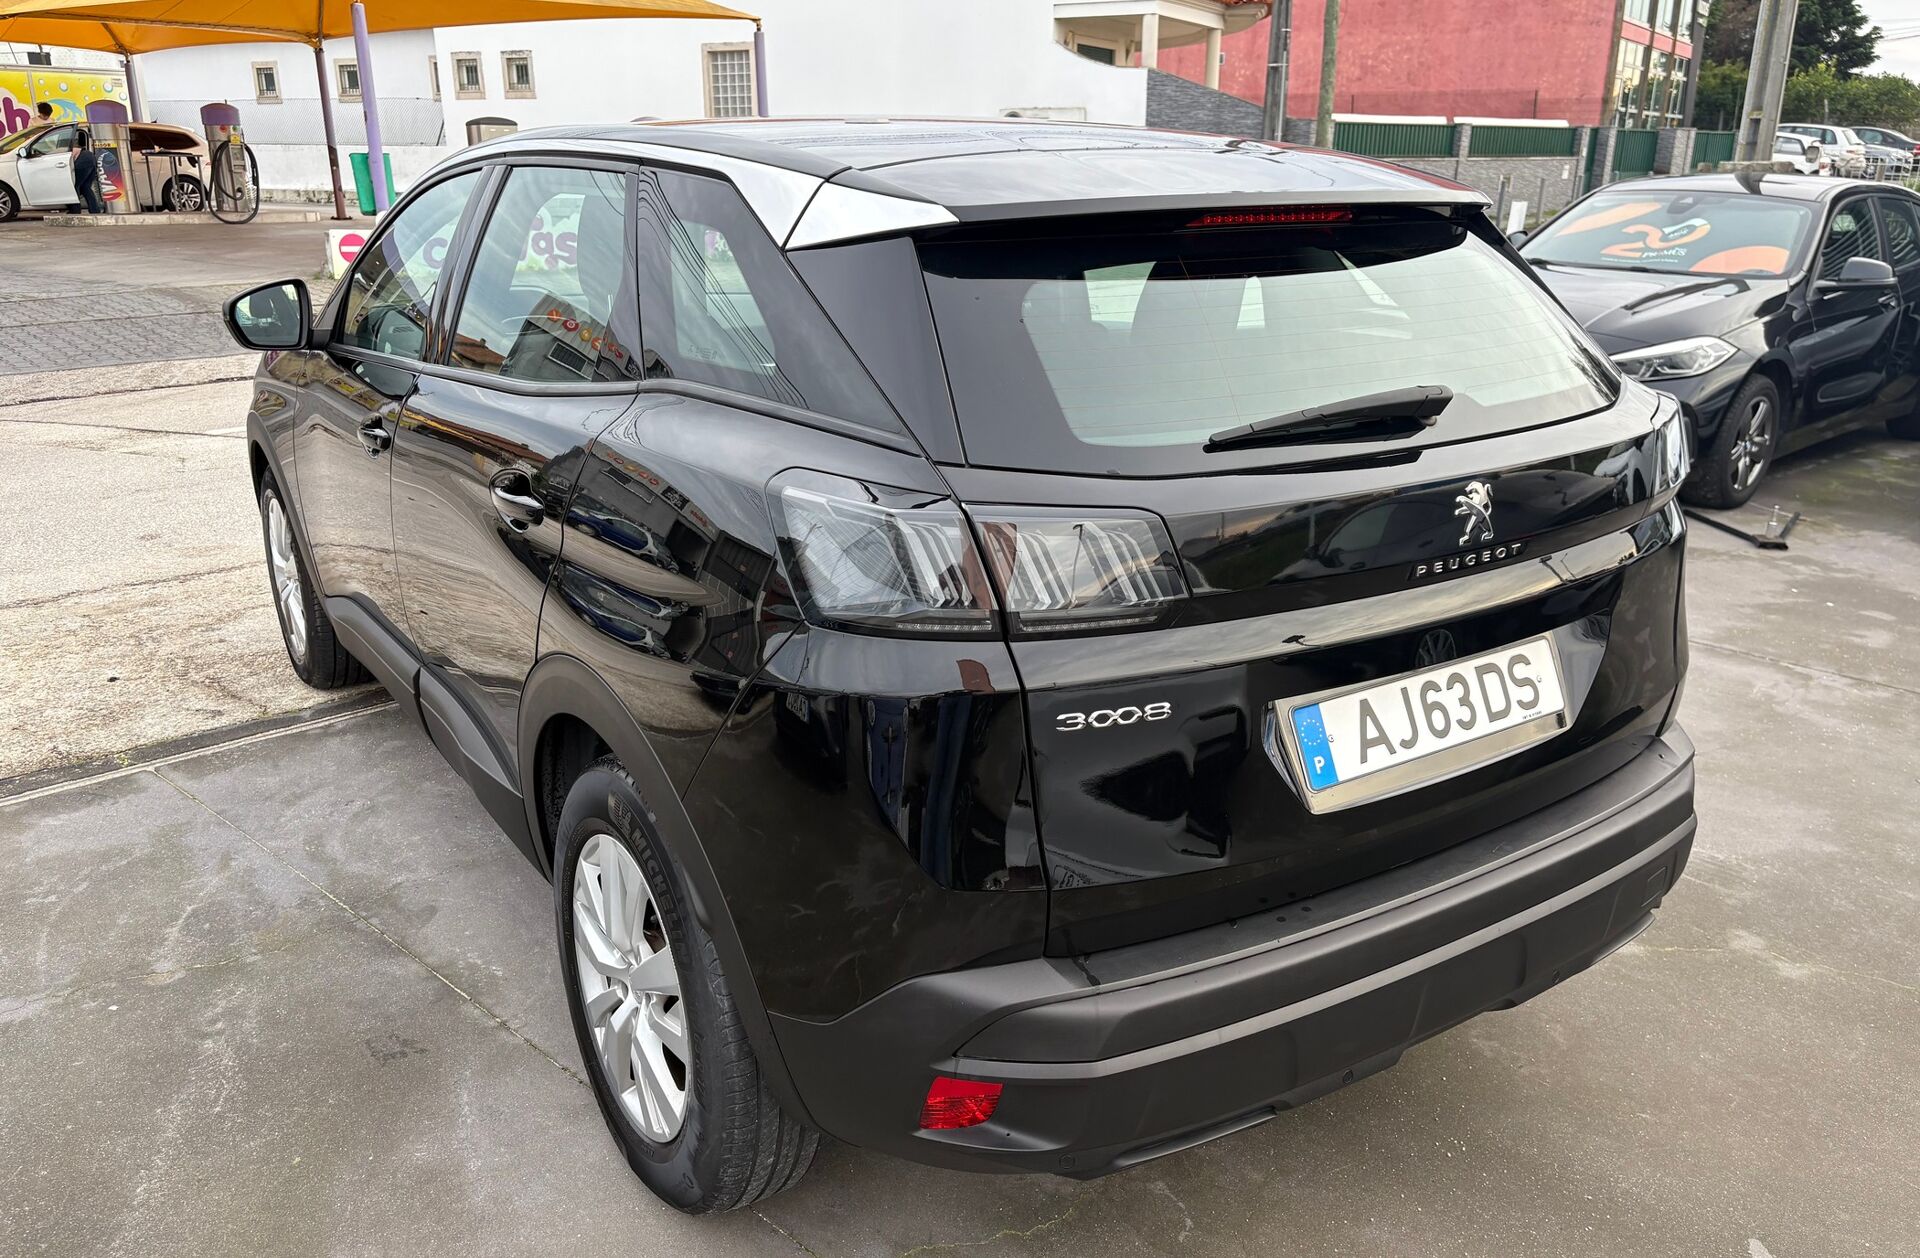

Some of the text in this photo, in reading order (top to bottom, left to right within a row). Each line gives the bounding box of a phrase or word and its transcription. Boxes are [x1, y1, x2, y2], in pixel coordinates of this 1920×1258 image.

[1415, 543, 1522, 578] PEUGEOT
[1056, 702, 1172, 732] 3008
[1358, 653, 1541, 765] AJ63DS
[1313, 755, 1326, 775] P
[630, 827, 691, 967] MICHELIN
